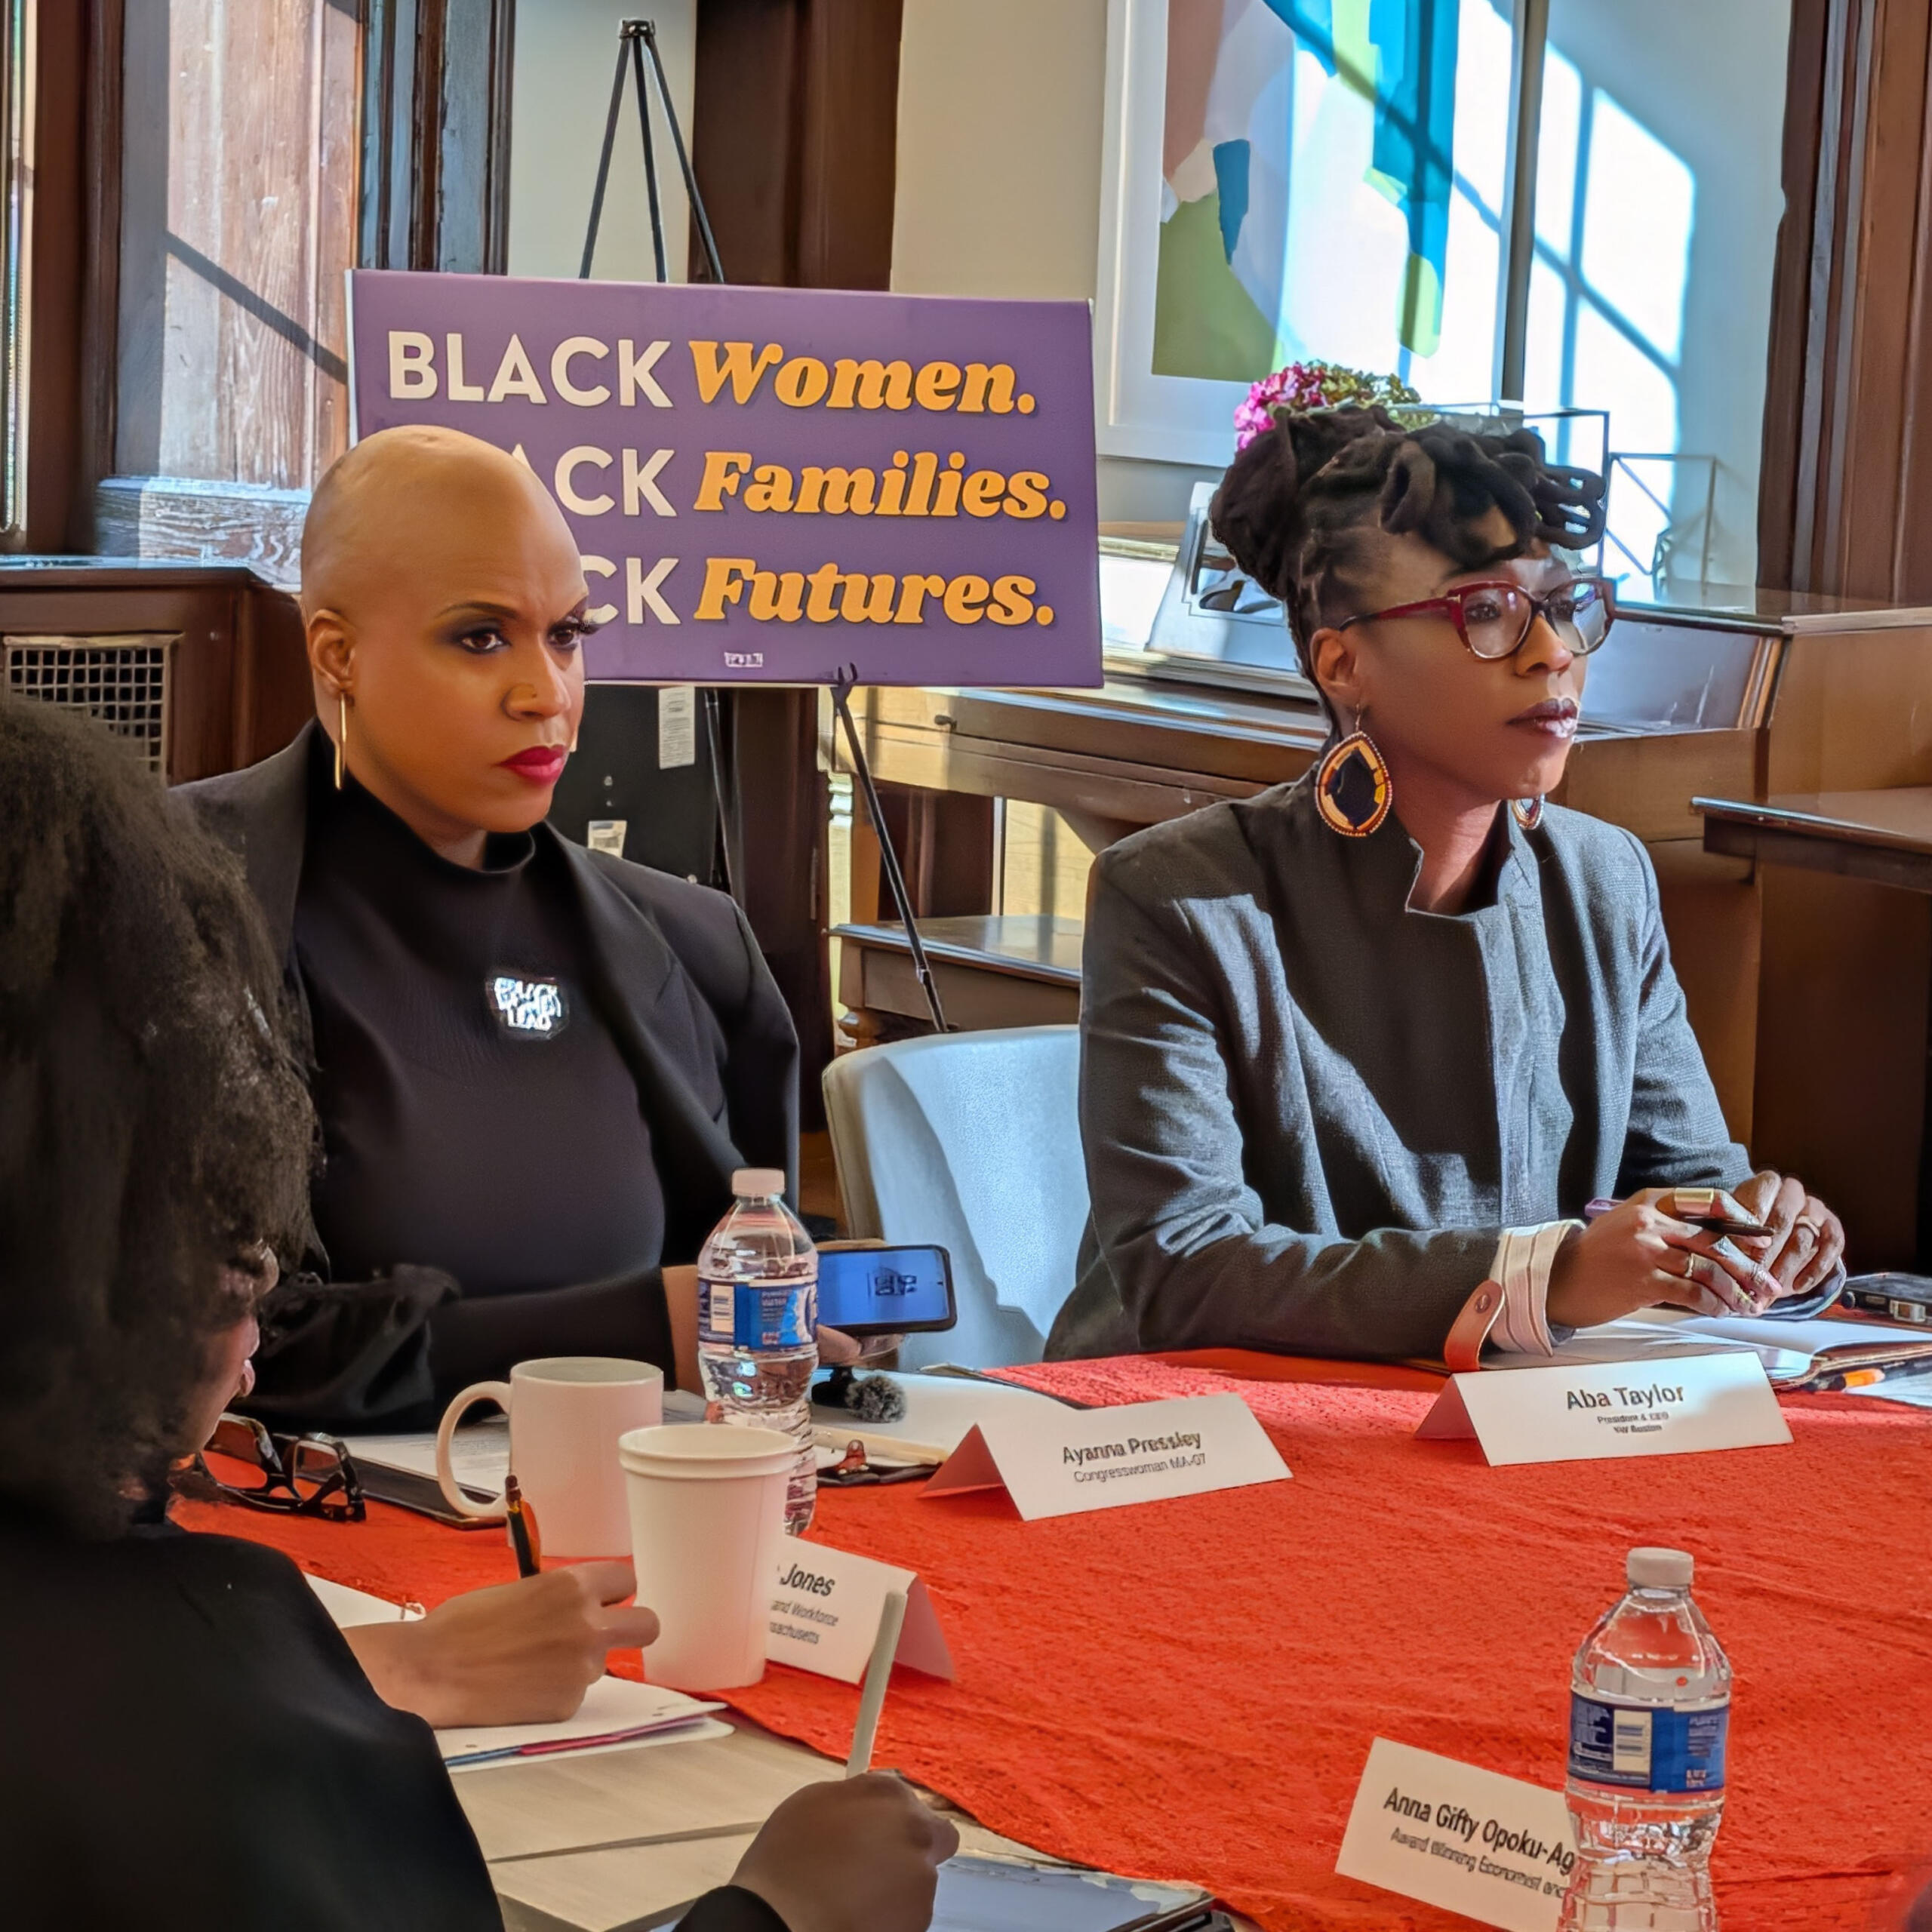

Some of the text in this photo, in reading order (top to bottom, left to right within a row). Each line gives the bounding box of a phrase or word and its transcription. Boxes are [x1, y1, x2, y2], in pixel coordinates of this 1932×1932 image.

[388, 330, 1035, 414] BLACK Women.
[694, 450, 1066, 520] Families.
[694, 557, 1054, 626] Futures.
[1567, 1383, 1684, 1410] Aba Taylor
[1063, 1432, 1201, 1465] Ayanna Pressley
[1074, 1453, 1207, 1481] Congresswoman MA-07
[780, 1563, 835, 1596] Jones
[792, 1603, 839, 1626] Workforce
[1383, 1787, 1432, 1823] Anna
[1436, 1804, 1480, 1843] Gifty
[1390, 1827, 1429, 1852] Award
